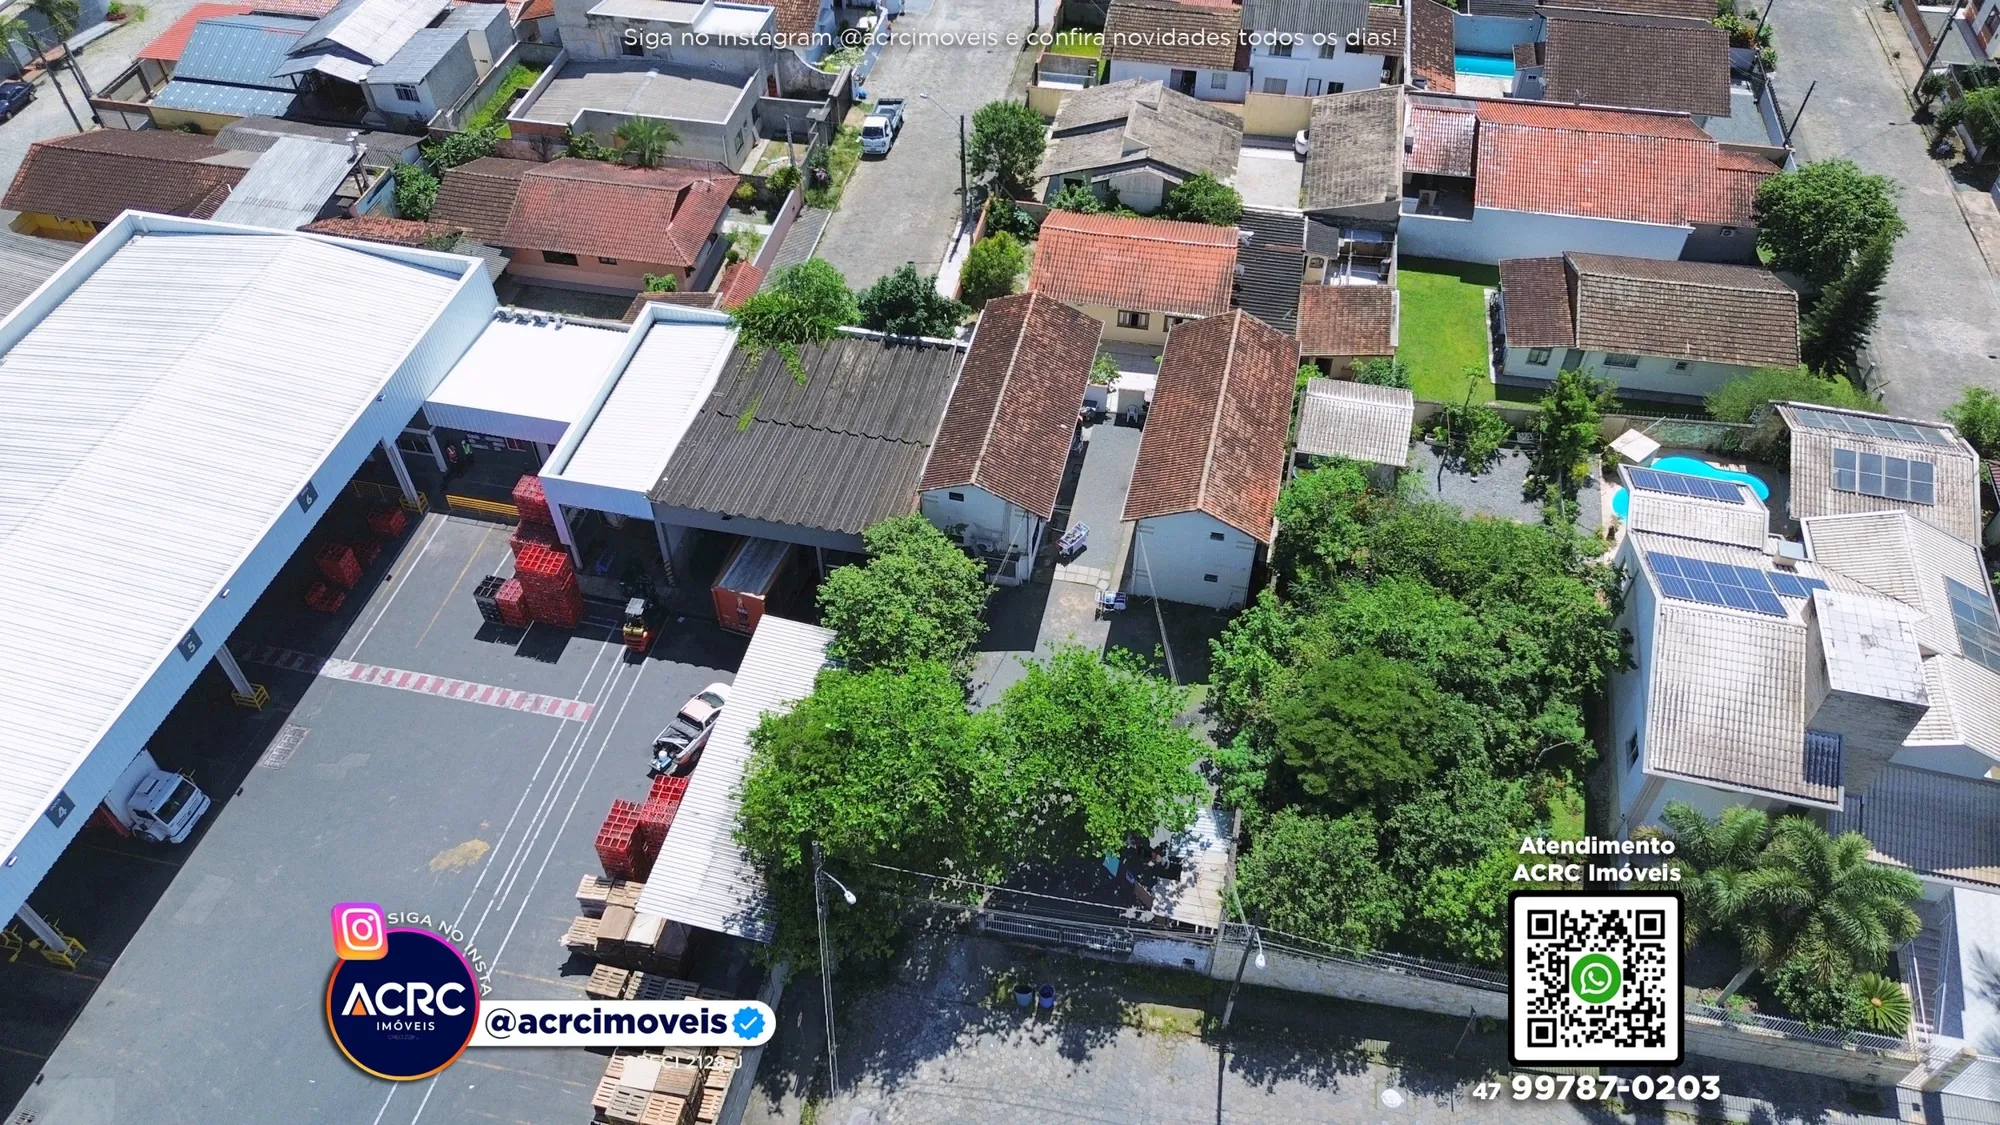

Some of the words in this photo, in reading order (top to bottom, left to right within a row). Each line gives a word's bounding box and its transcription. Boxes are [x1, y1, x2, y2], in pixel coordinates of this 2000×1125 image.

[306, 494, 313, 505] 6
[187, 640, 196, 653] 5
[58, 805, 67, 818] 4
